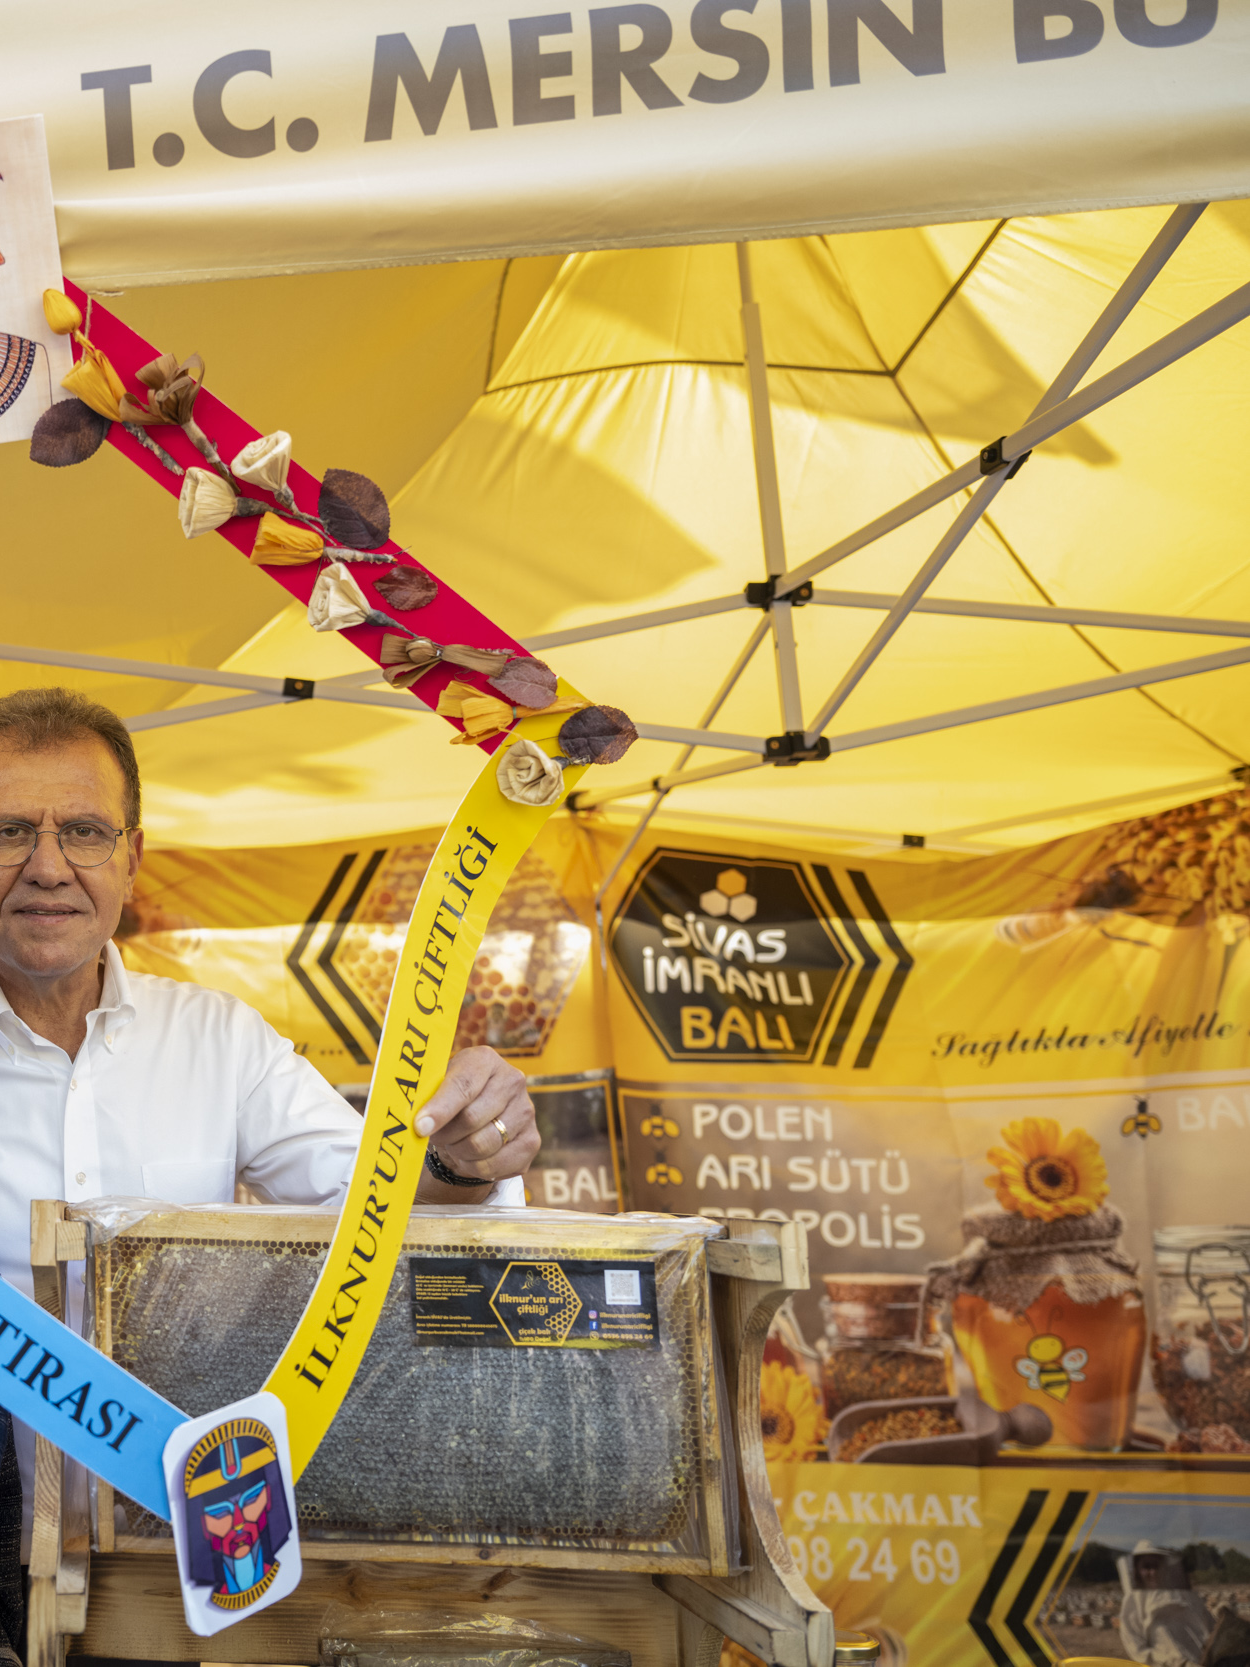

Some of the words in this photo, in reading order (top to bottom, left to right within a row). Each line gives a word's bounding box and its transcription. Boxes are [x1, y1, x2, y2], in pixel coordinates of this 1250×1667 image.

[80, 48, 320, 172] T.C.
[661, 911, 788, 964] SİVAS
[394, 1017, 431, 1111] ARI
[413, 824, 500, 1016] ÇİFTLİĞİ
[641, 946, 814, 1006] İMRANLI
[680, 1006, 795, 1051] BALI
[692, 1103, 834, 1142] POLEN
[1176, 1093, 1250, 1132] BA
[696, 1154, 772, 1191] ARI
[787, 1149, 911, 1195] SÜTÜ
[499, 1293, 547, 1304] ilknur'un
[549, 1296, 564, 1304] arı
[517, 1304, 549, 1316] çiftliği
[792, 1490, 982, 1533] ÇAKMAK
[846, 1537, 898, 1582] 24
[910, 1538, 961, 1585] 69
